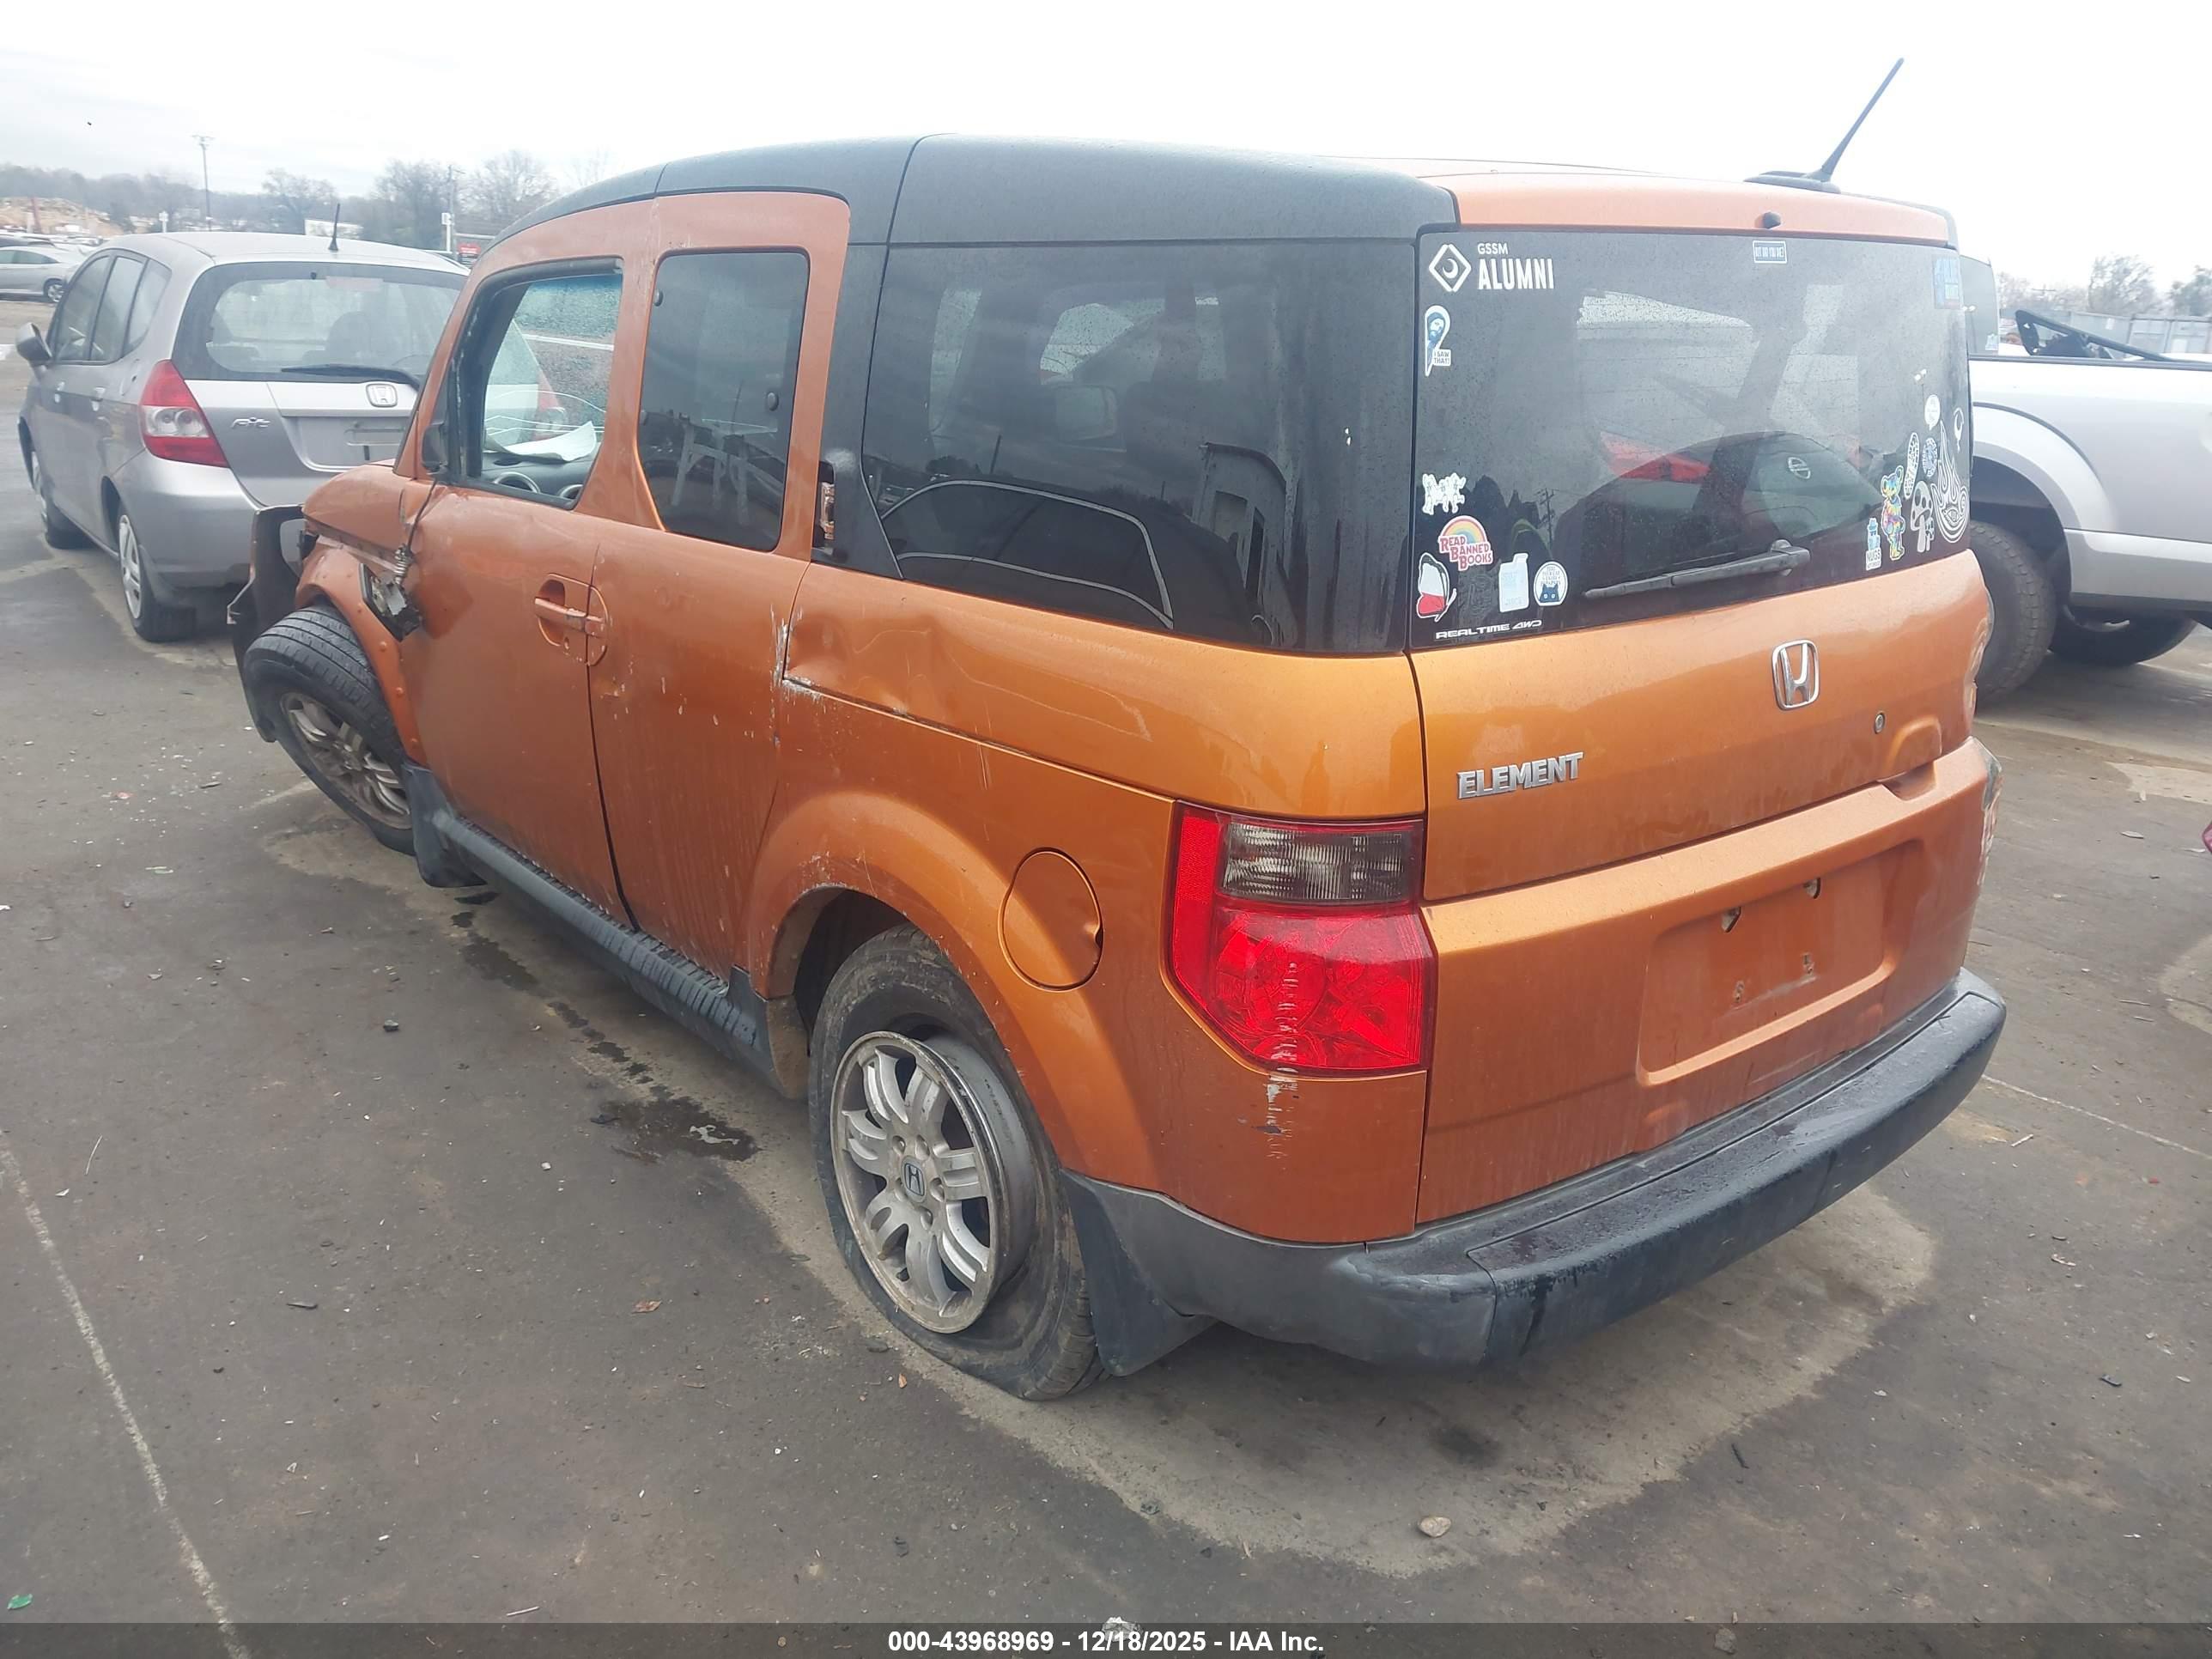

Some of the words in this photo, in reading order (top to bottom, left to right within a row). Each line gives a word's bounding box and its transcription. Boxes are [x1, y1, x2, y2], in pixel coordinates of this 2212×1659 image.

[1477, 243, 1509, 255] GSSM
[1477, 258, 1554, 289] ALUMNI
[1440, 536, 1466, 552] READ
[1450, 543, 1490, 561] BANNED
[1459, 553, 1492, 570] BOOKS
[1512, 620, 1542, 629] 4WD
[1457, 751, 1584, 799] ELEMENT
